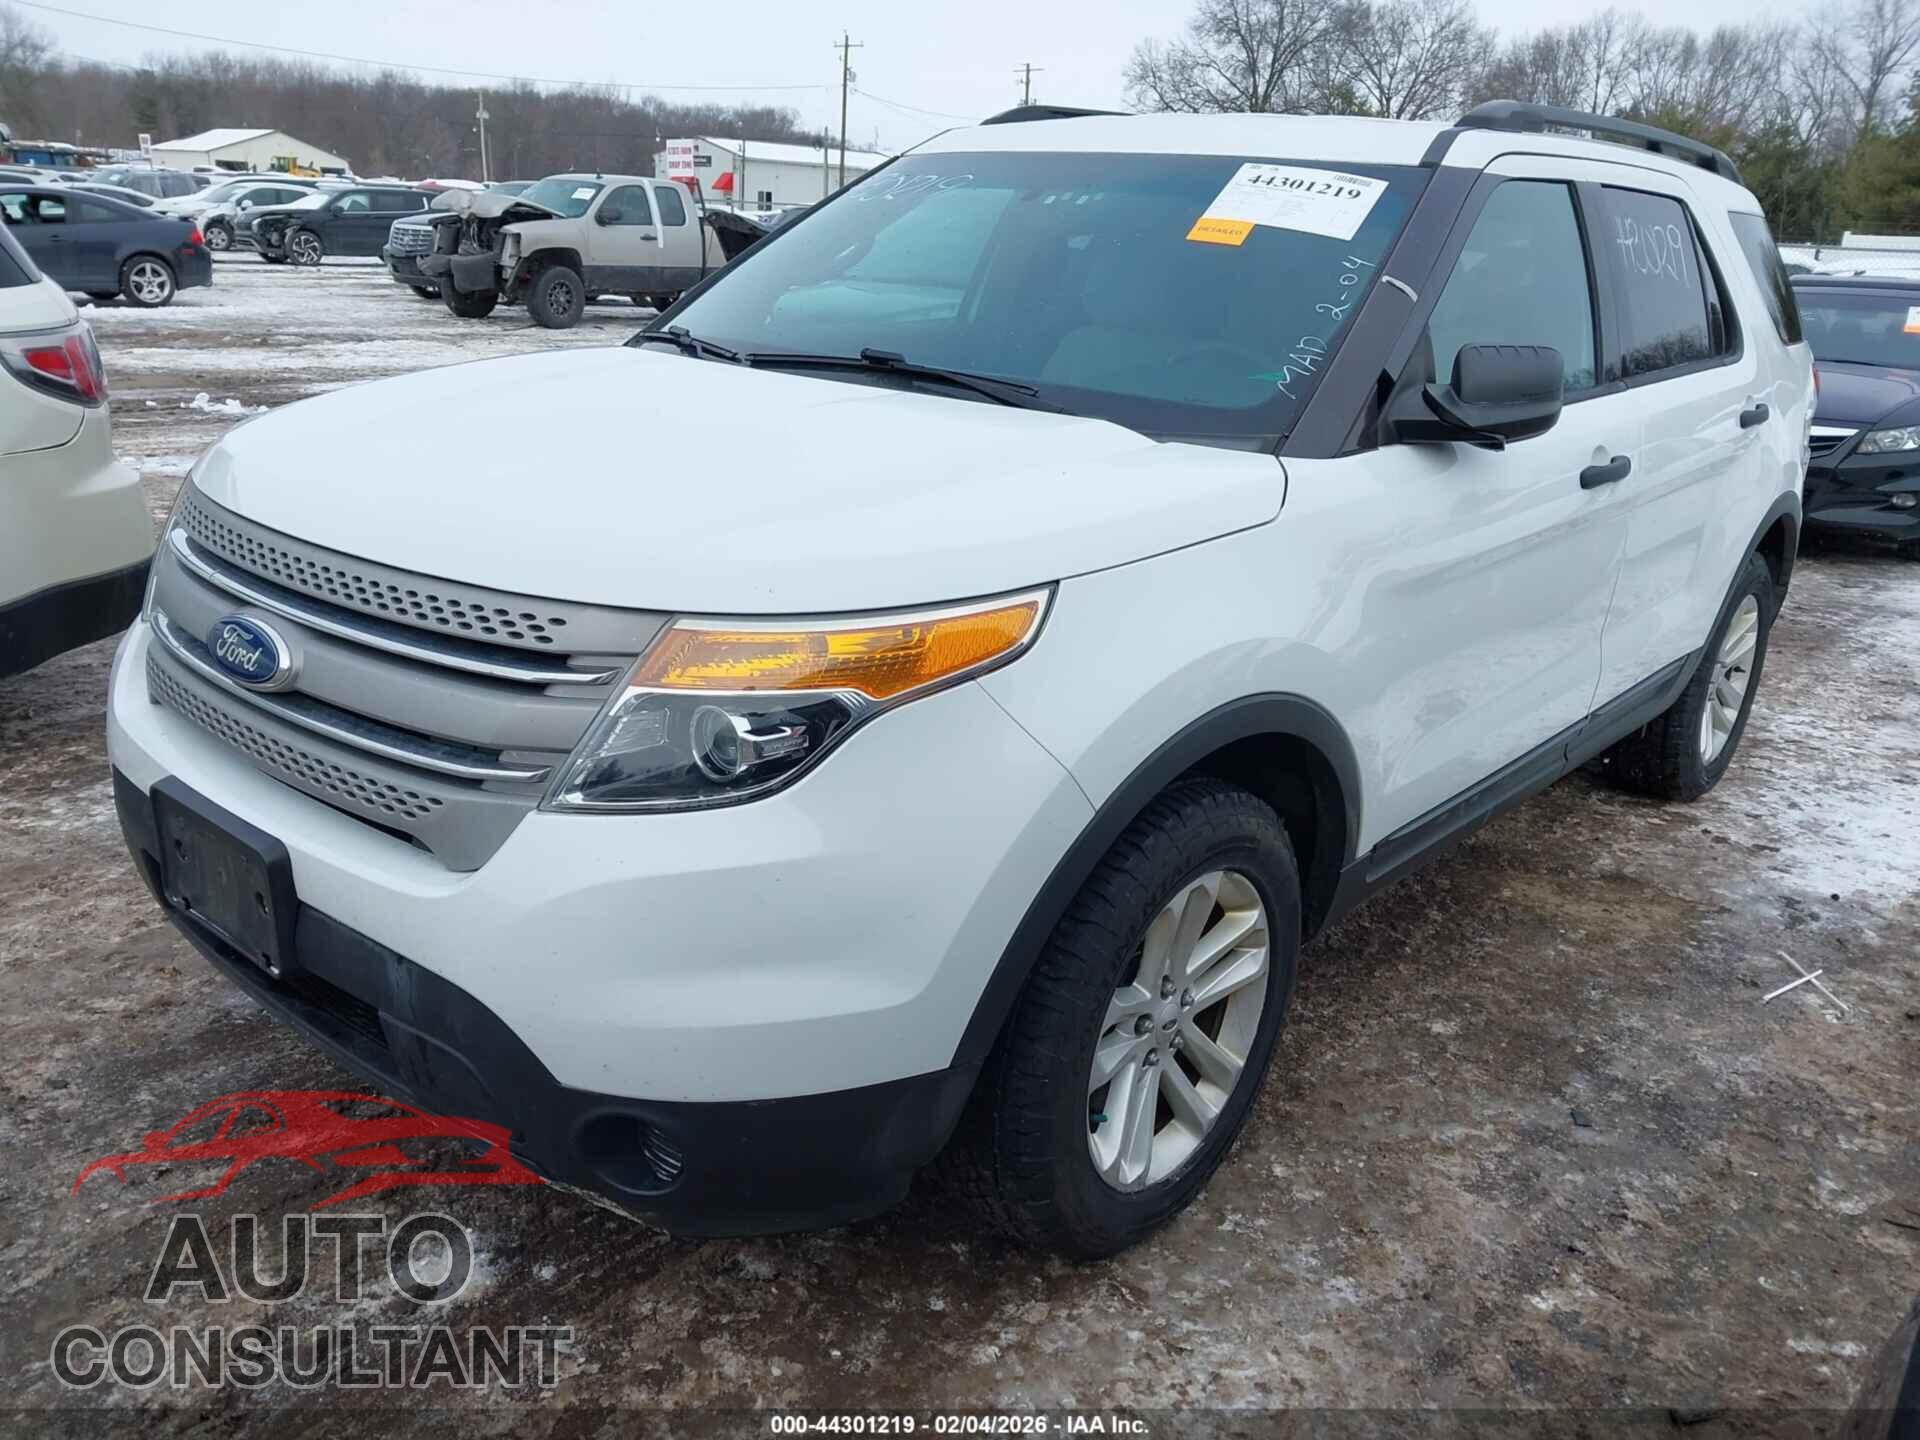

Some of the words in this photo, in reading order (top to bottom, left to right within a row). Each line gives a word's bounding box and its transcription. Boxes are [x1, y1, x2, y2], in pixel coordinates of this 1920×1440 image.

[1248, 173, 1361, 200] 44301219
[1276, 335, 1329, 400] MAD
[1314, 255, 1377, 321] 2-04
[217, 624, 262, 671] Ford
